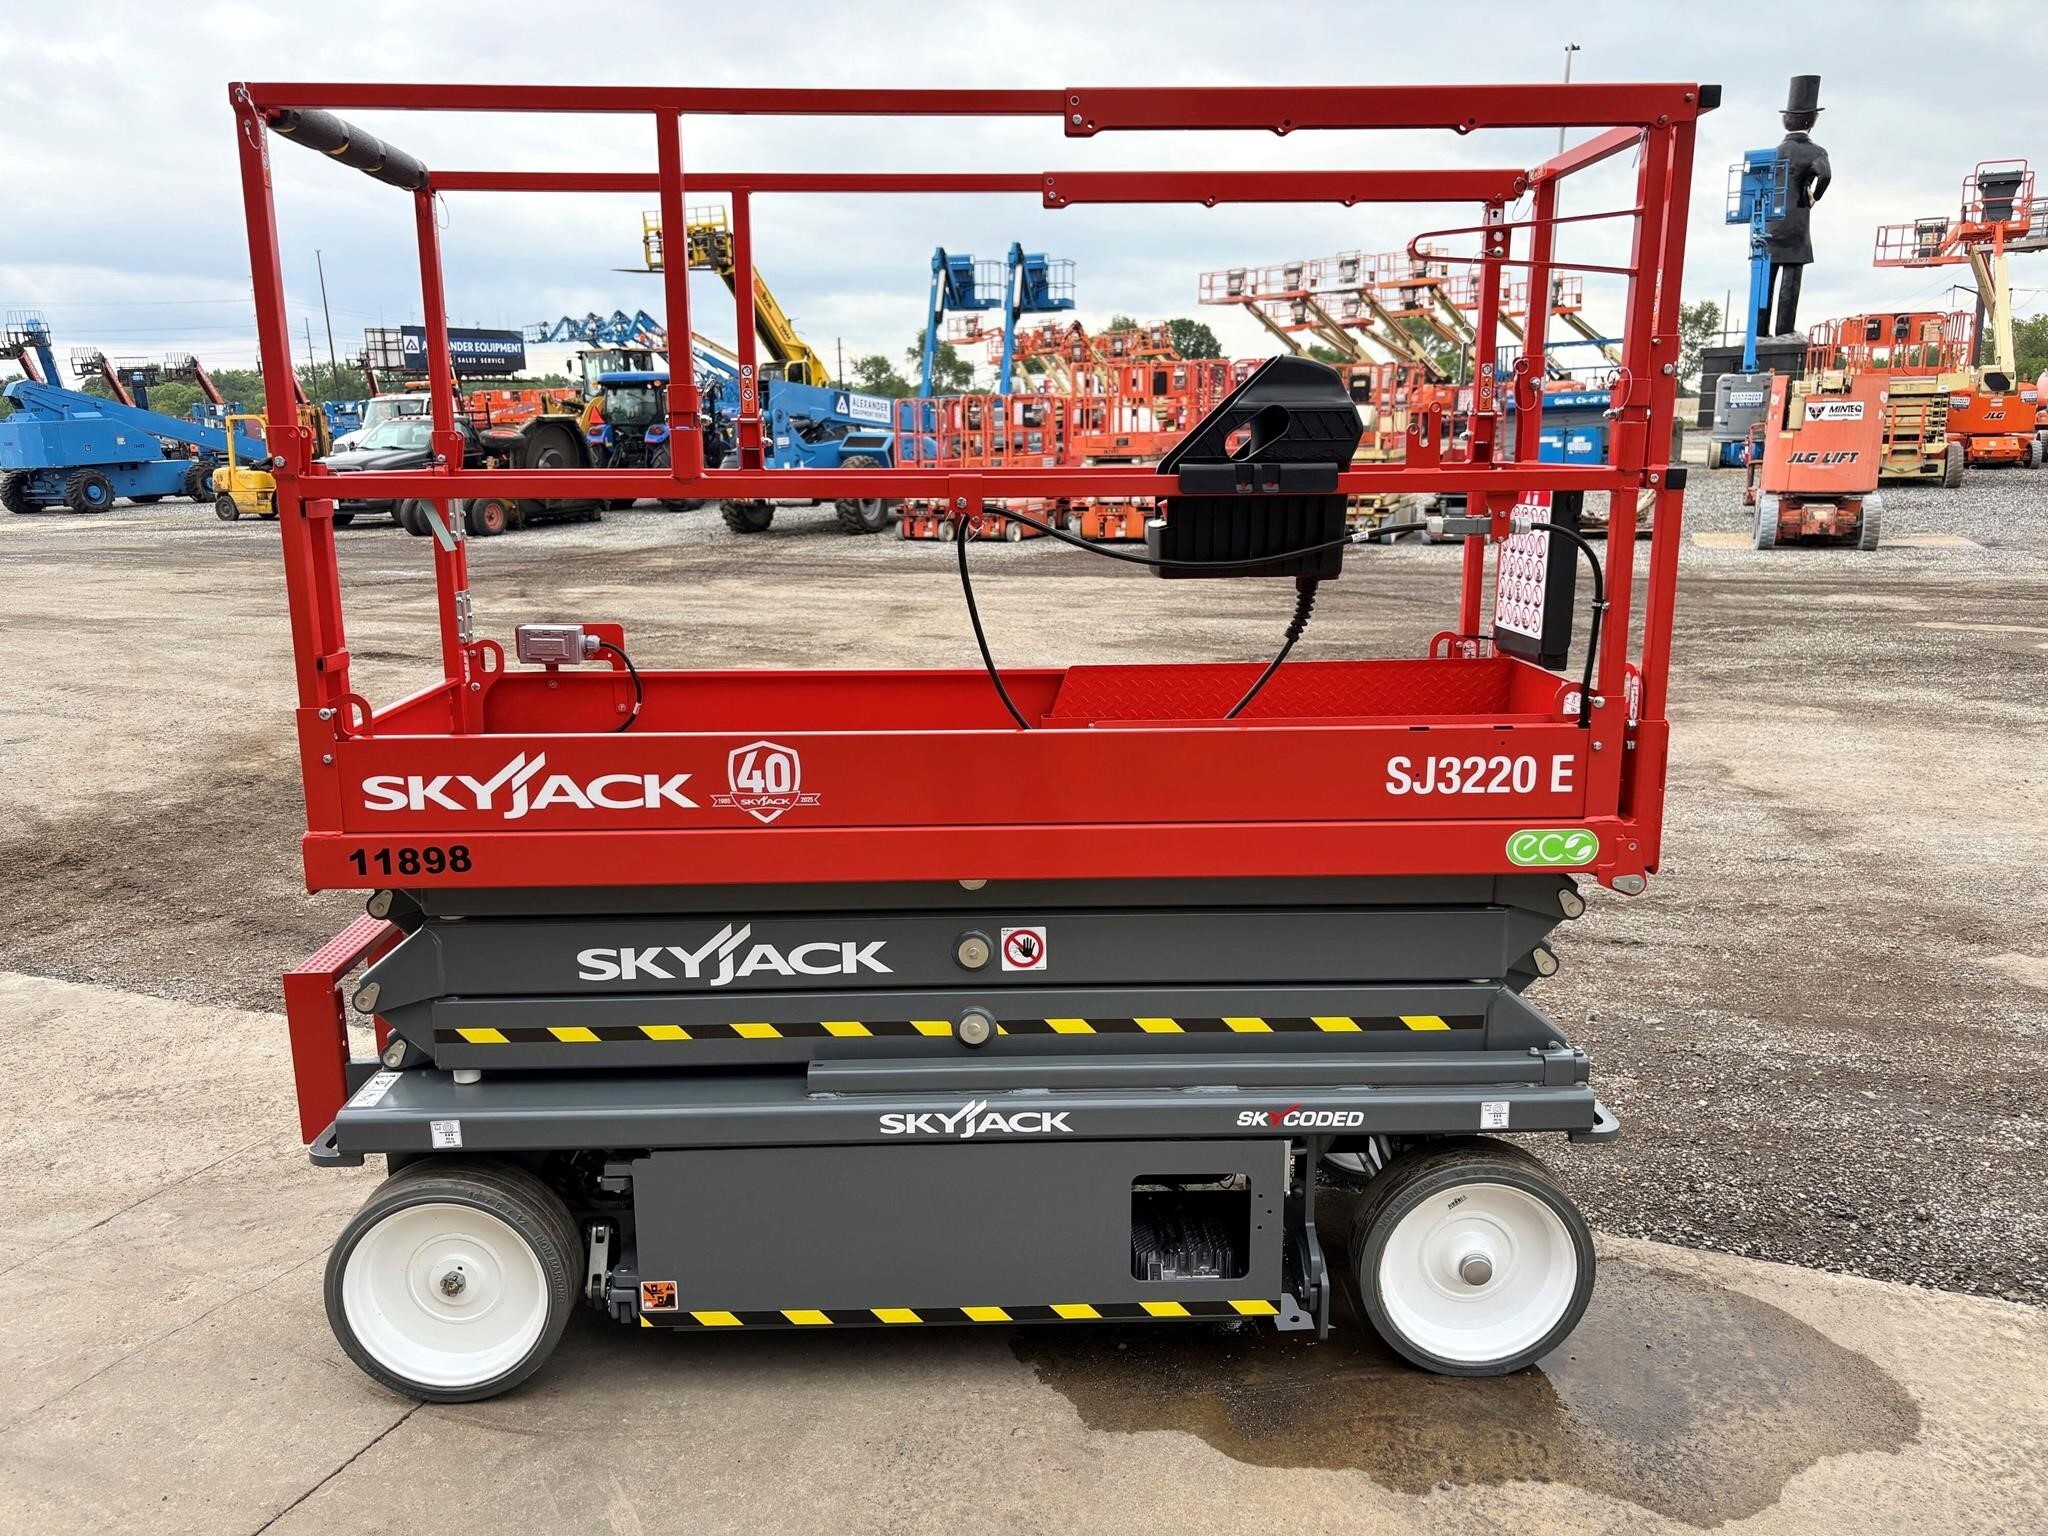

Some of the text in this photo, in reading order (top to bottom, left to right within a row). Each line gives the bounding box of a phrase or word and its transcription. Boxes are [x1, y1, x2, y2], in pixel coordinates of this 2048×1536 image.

[475, 342, 522, 353] EQUIPMENT
[852, 397, 888, 412] ALEXANDER
[1829, 404, 1862, 413] MINTEQ
[1787, 452, 1859, 464] JLG LIFT
[361, 751, 701, 819] SKYJACK
[737, 751, 791, 793] 40
[1386, 754, 1575, 795] SJ3220 E
[741, 796, 791, 807] SKYJACK
[349, 845, 473, 877] 11898
[1513, 833, 1593, 863] eco
[576, 922, 895, 986] SKYJACK
[879, 1100, 1074, 1138] SKYJACK
[1236, 1104, 1365, 1128] SKYCODED
[1378, 1208, 1397, 1229] NON
[1394, 1179, 1439, 1209] MARKING
[535, 1234, 567, 1303] NON MARKING
